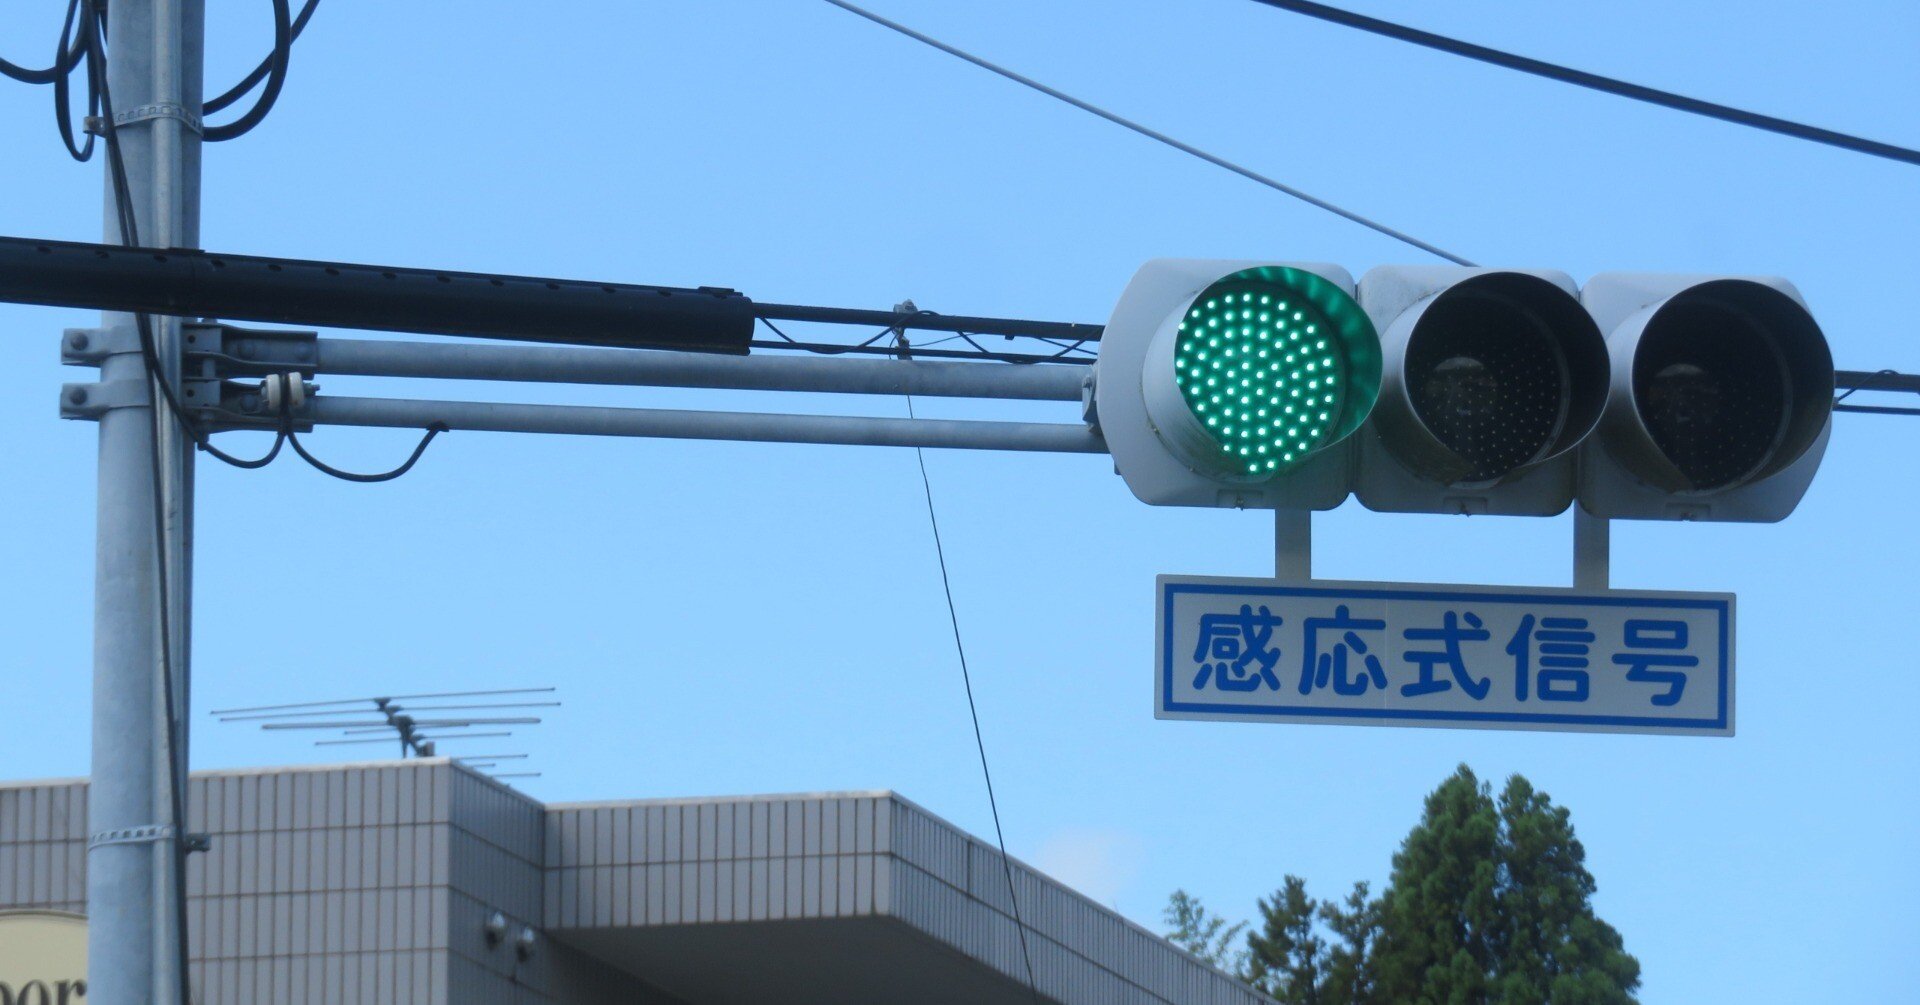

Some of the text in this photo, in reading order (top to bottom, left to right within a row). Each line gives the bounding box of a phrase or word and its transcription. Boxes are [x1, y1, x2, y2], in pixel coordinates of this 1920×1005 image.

[1192, 604, 1700, 707] 感応式信号
